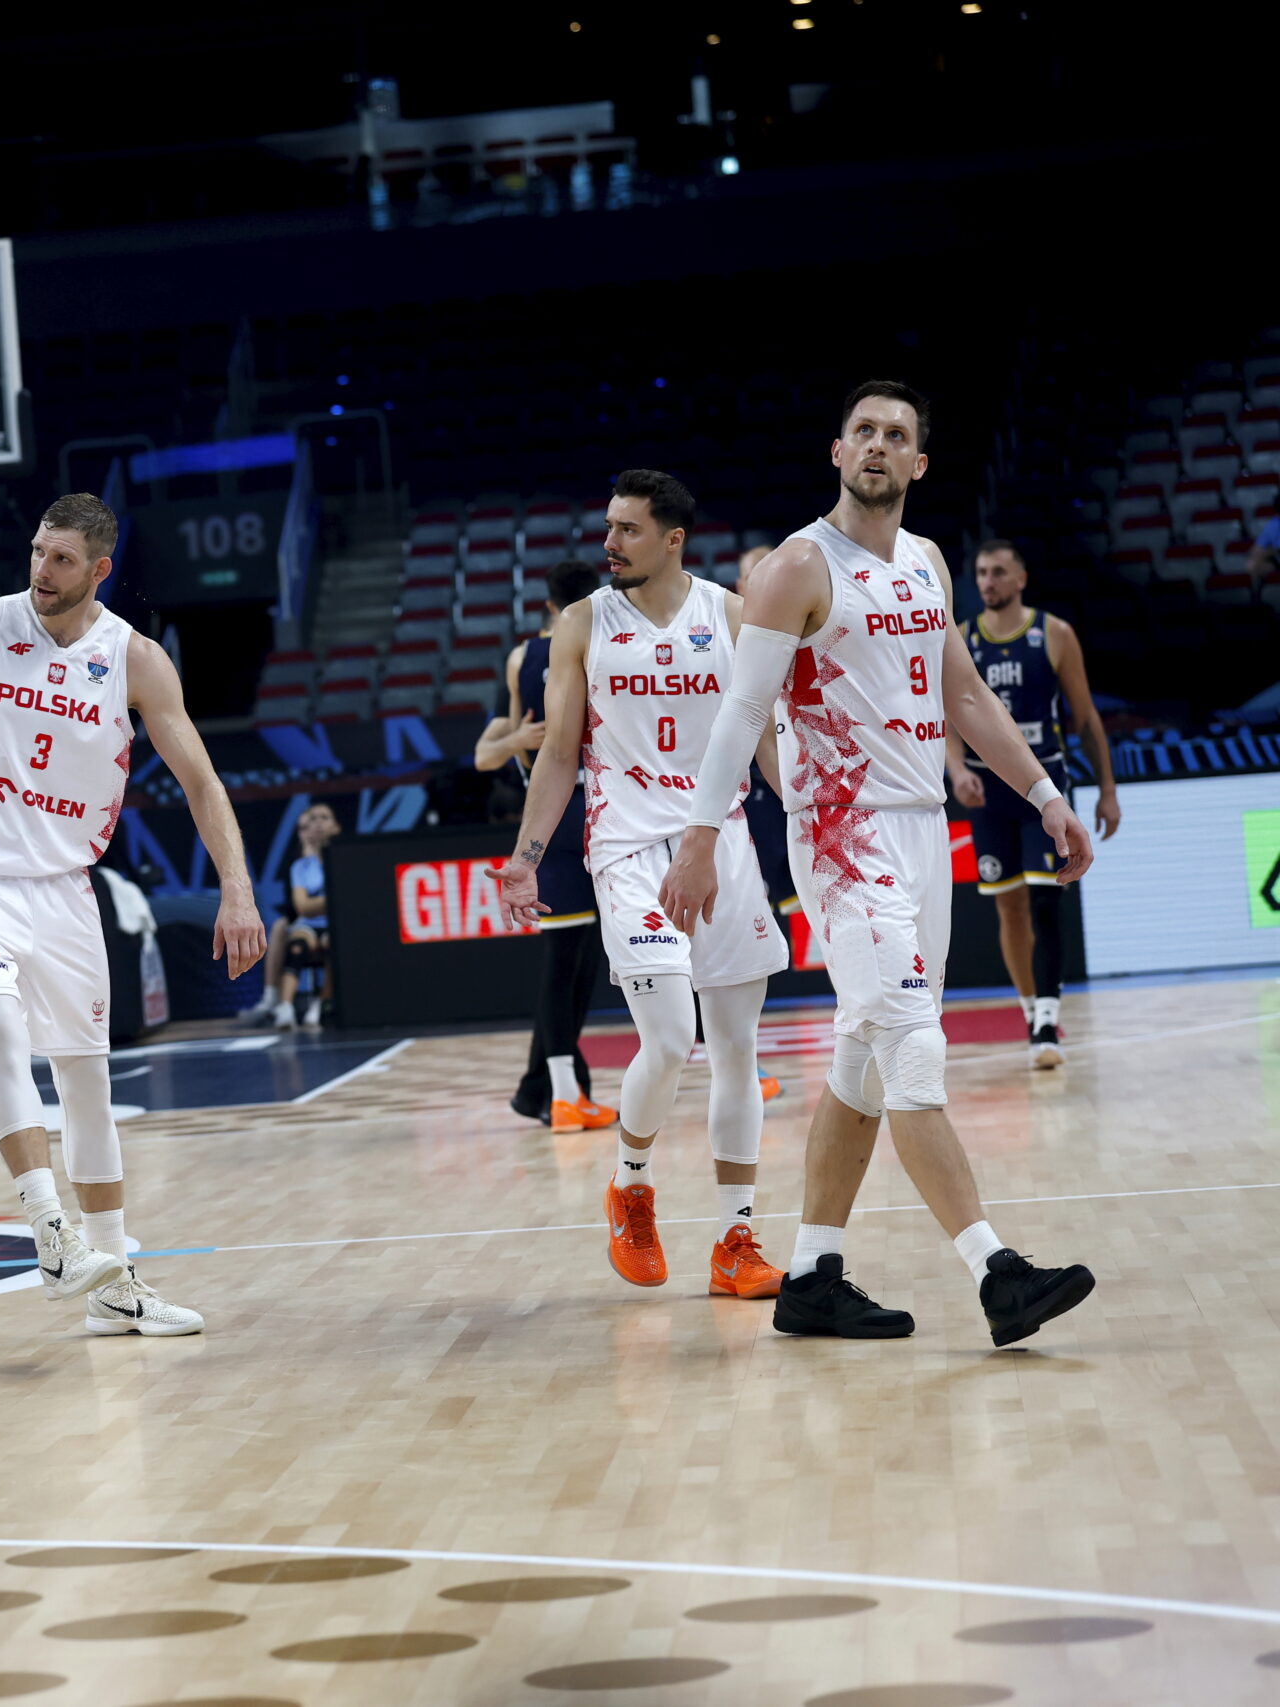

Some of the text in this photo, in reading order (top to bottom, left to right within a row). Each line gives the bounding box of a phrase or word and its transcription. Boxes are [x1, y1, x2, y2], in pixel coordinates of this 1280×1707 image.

[179, 513, 265, 560] 108
[8, 642, 34, 655] 4F
[610, 632, 636, 645] 4F
[609, 673, 720, 696] POLSKA
[910, 656, 928, 696] 9
[987, 661, 1023, 688] BIH
[658, 716, 676, 752] 0
[30, 733, 53, 770] 3
[22, 789, 86, 819] ORLEN
[629, 934, 678, 945] SUZUKI
[901, 979, 928, 988] SUZU
